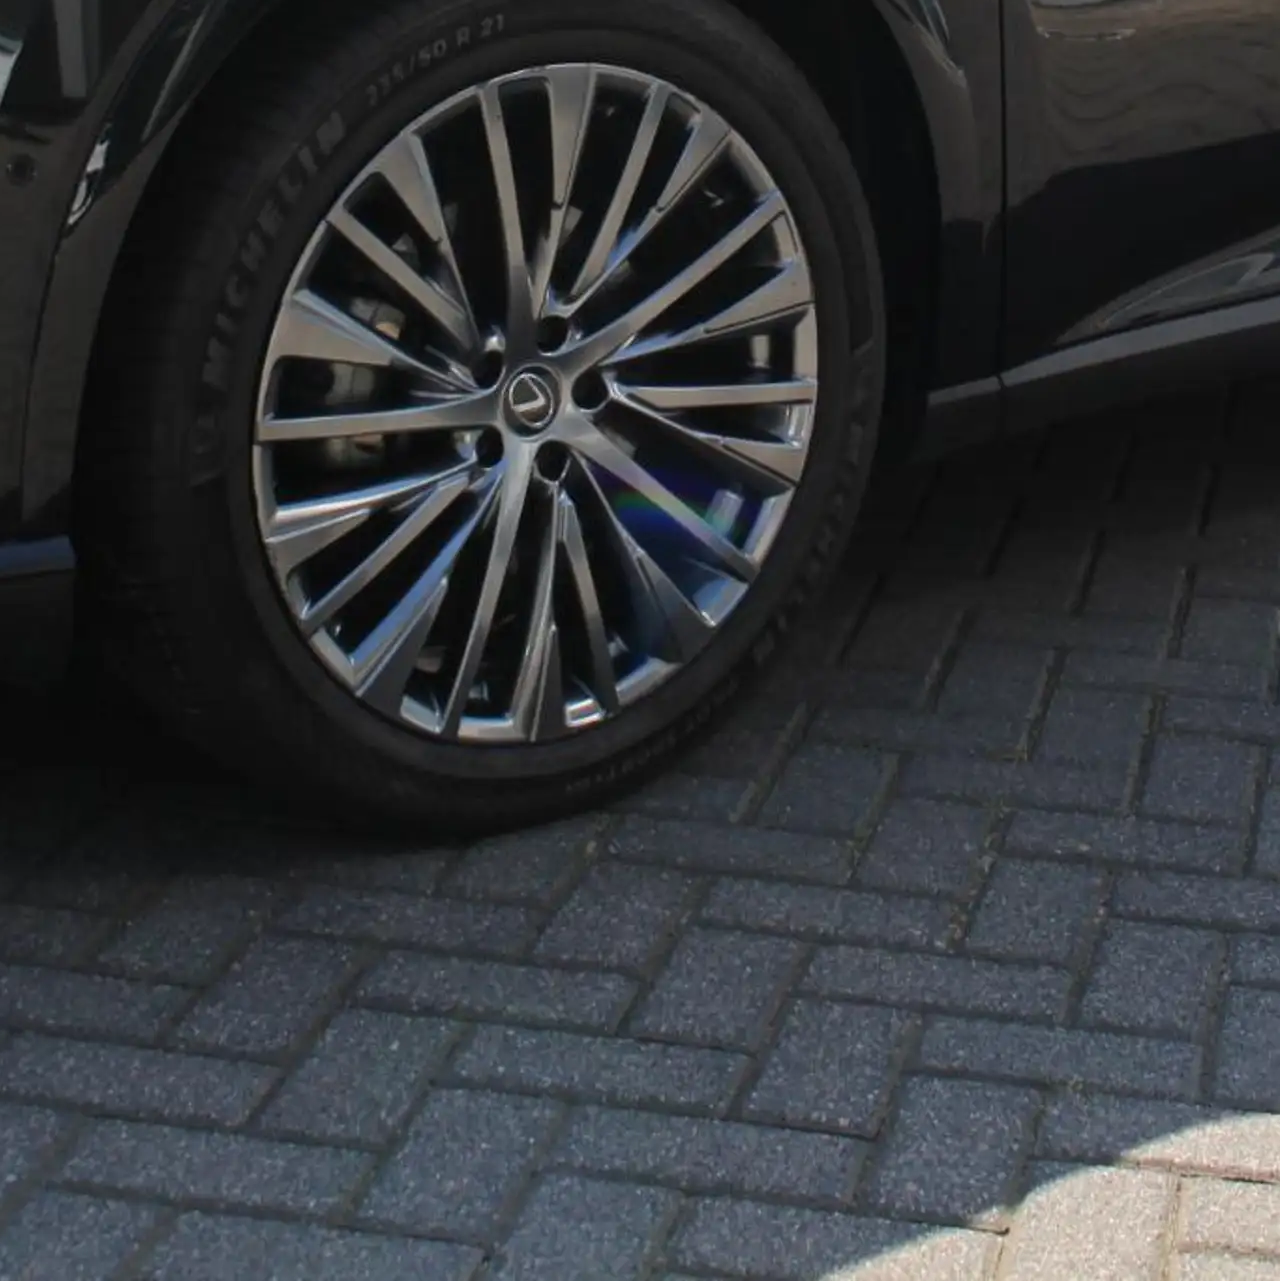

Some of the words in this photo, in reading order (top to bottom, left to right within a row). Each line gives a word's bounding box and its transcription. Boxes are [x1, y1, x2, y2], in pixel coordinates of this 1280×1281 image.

[202, 111, 348, 391] MICHELIN
[456, 27, 471, 47] R
[480, 12, 506, 38] 21
